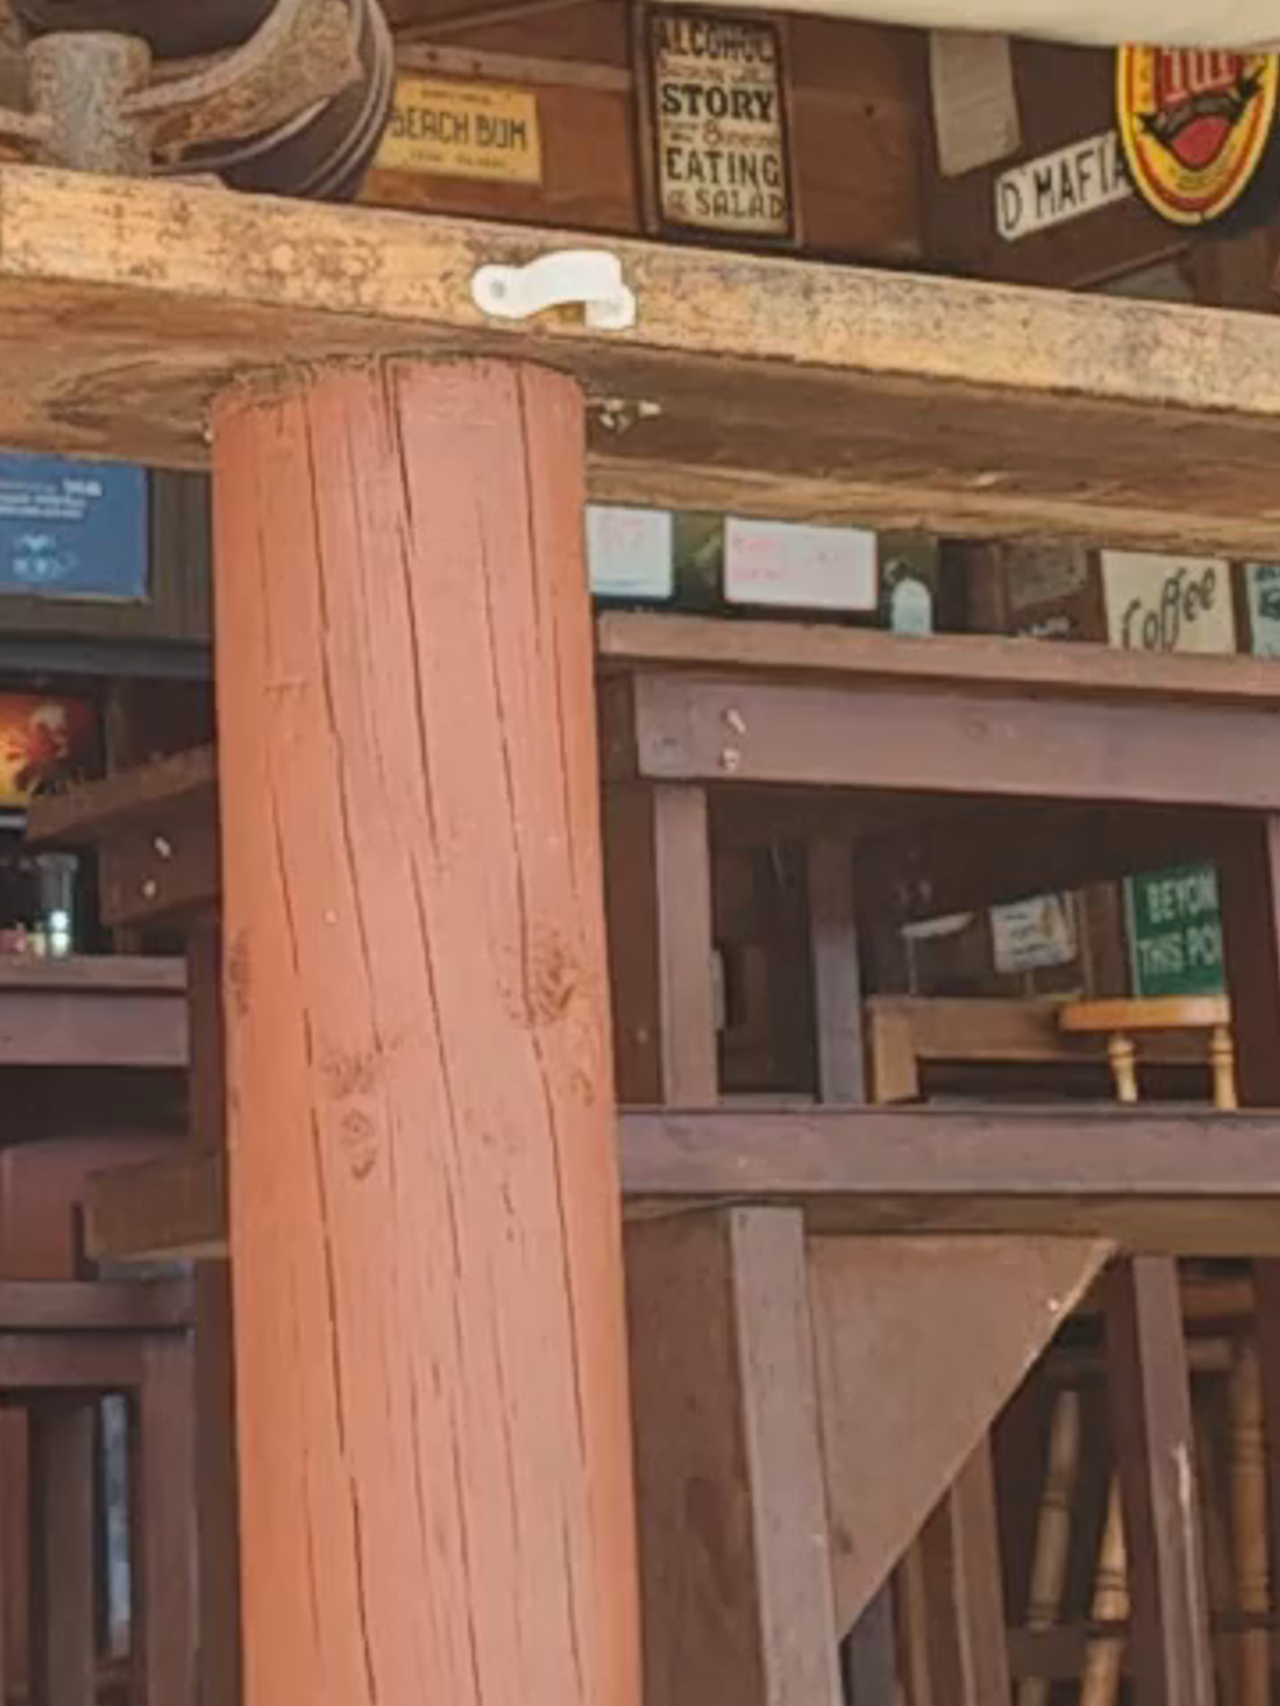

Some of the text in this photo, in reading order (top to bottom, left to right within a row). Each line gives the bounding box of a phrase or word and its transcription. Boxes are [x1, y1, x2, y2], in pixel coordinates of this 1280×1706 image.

[662, 82, 774, 122] STORY
[390, 105, 528, 151] BEACH BUM
[666, 146, 780, 187] EATING
[694, 189, 784, 220] SALAD
